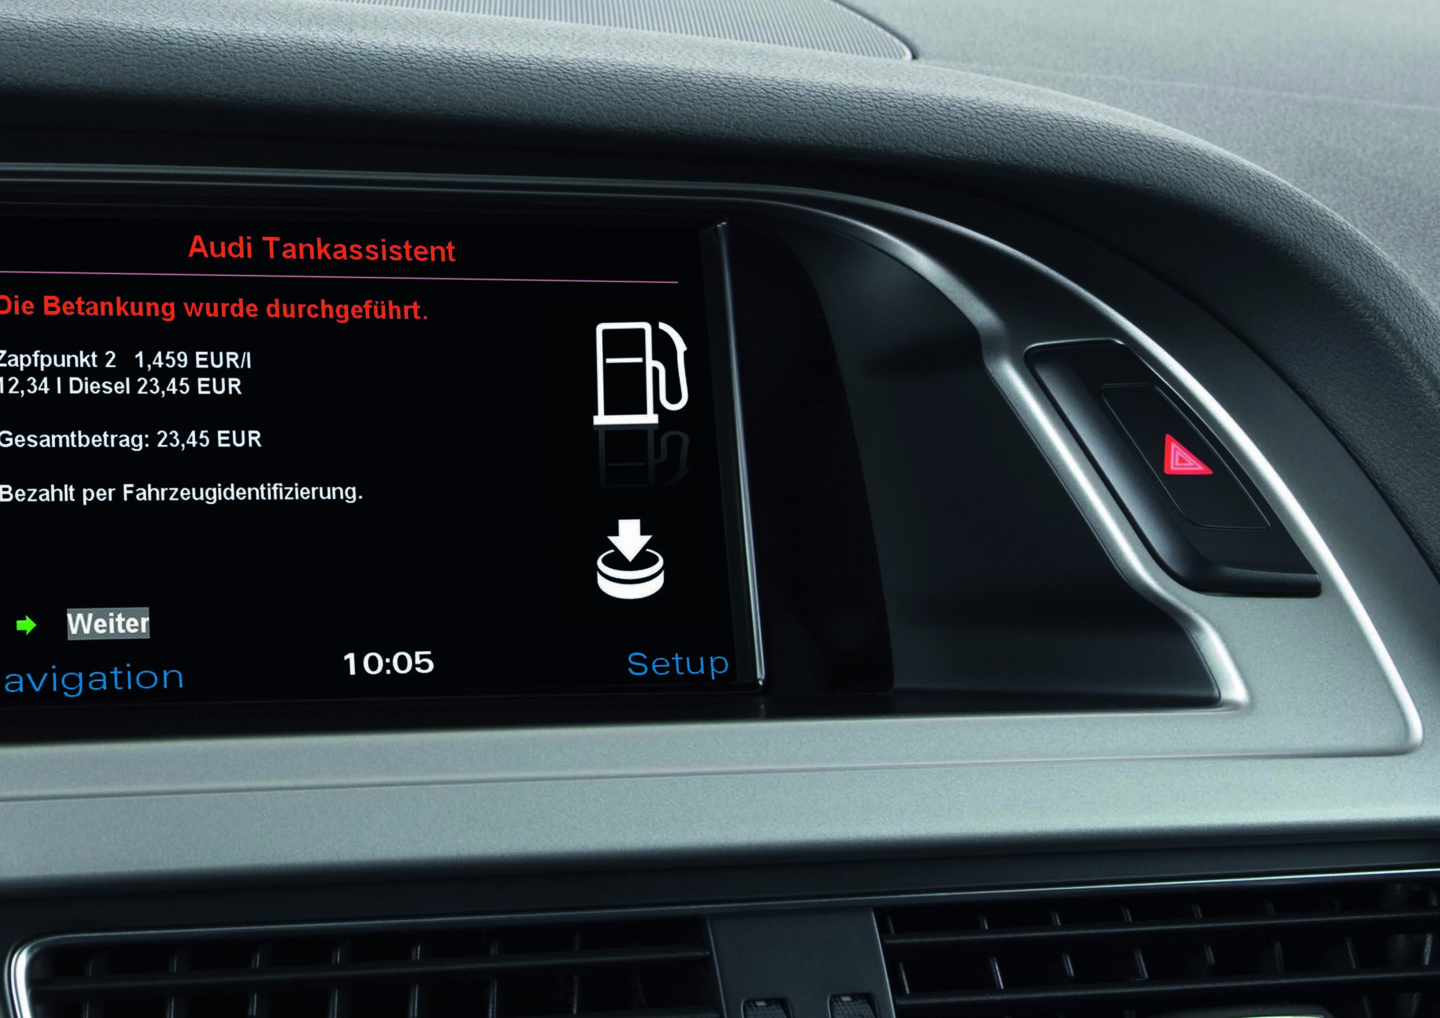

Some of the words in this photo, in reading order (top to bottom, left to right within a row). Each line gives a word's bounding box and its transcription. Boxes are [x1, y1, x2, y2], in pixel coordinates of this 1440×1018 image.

[188, 234, 253, 259] Audi
[261, 236, 456, 263] Tankassistent
[43, 295, 176, 322] Betankung
[183, 297, 259, 318] wurde
[265, 298, 428, 324] durchgeführt.
[104, 350, 117, 368] 2
[134, 350, 188, 372] 1,459
[68, 376, 131, 395] Diesel
[136, 376, 190, 399] 23,45
[197, 377, 243, 395] EUR
[156, 429, 210, 452] 23,45
[217, 429, 262, 448] EUR
[82, 487, 117, 506] per
[122, 482, 363, 505] Fahrzeugidentifizierung.
[67, 612, 150, 635] Weiter
[343, 650, 435, 676] 10:05
[628, 651, 729, 680] Setup
